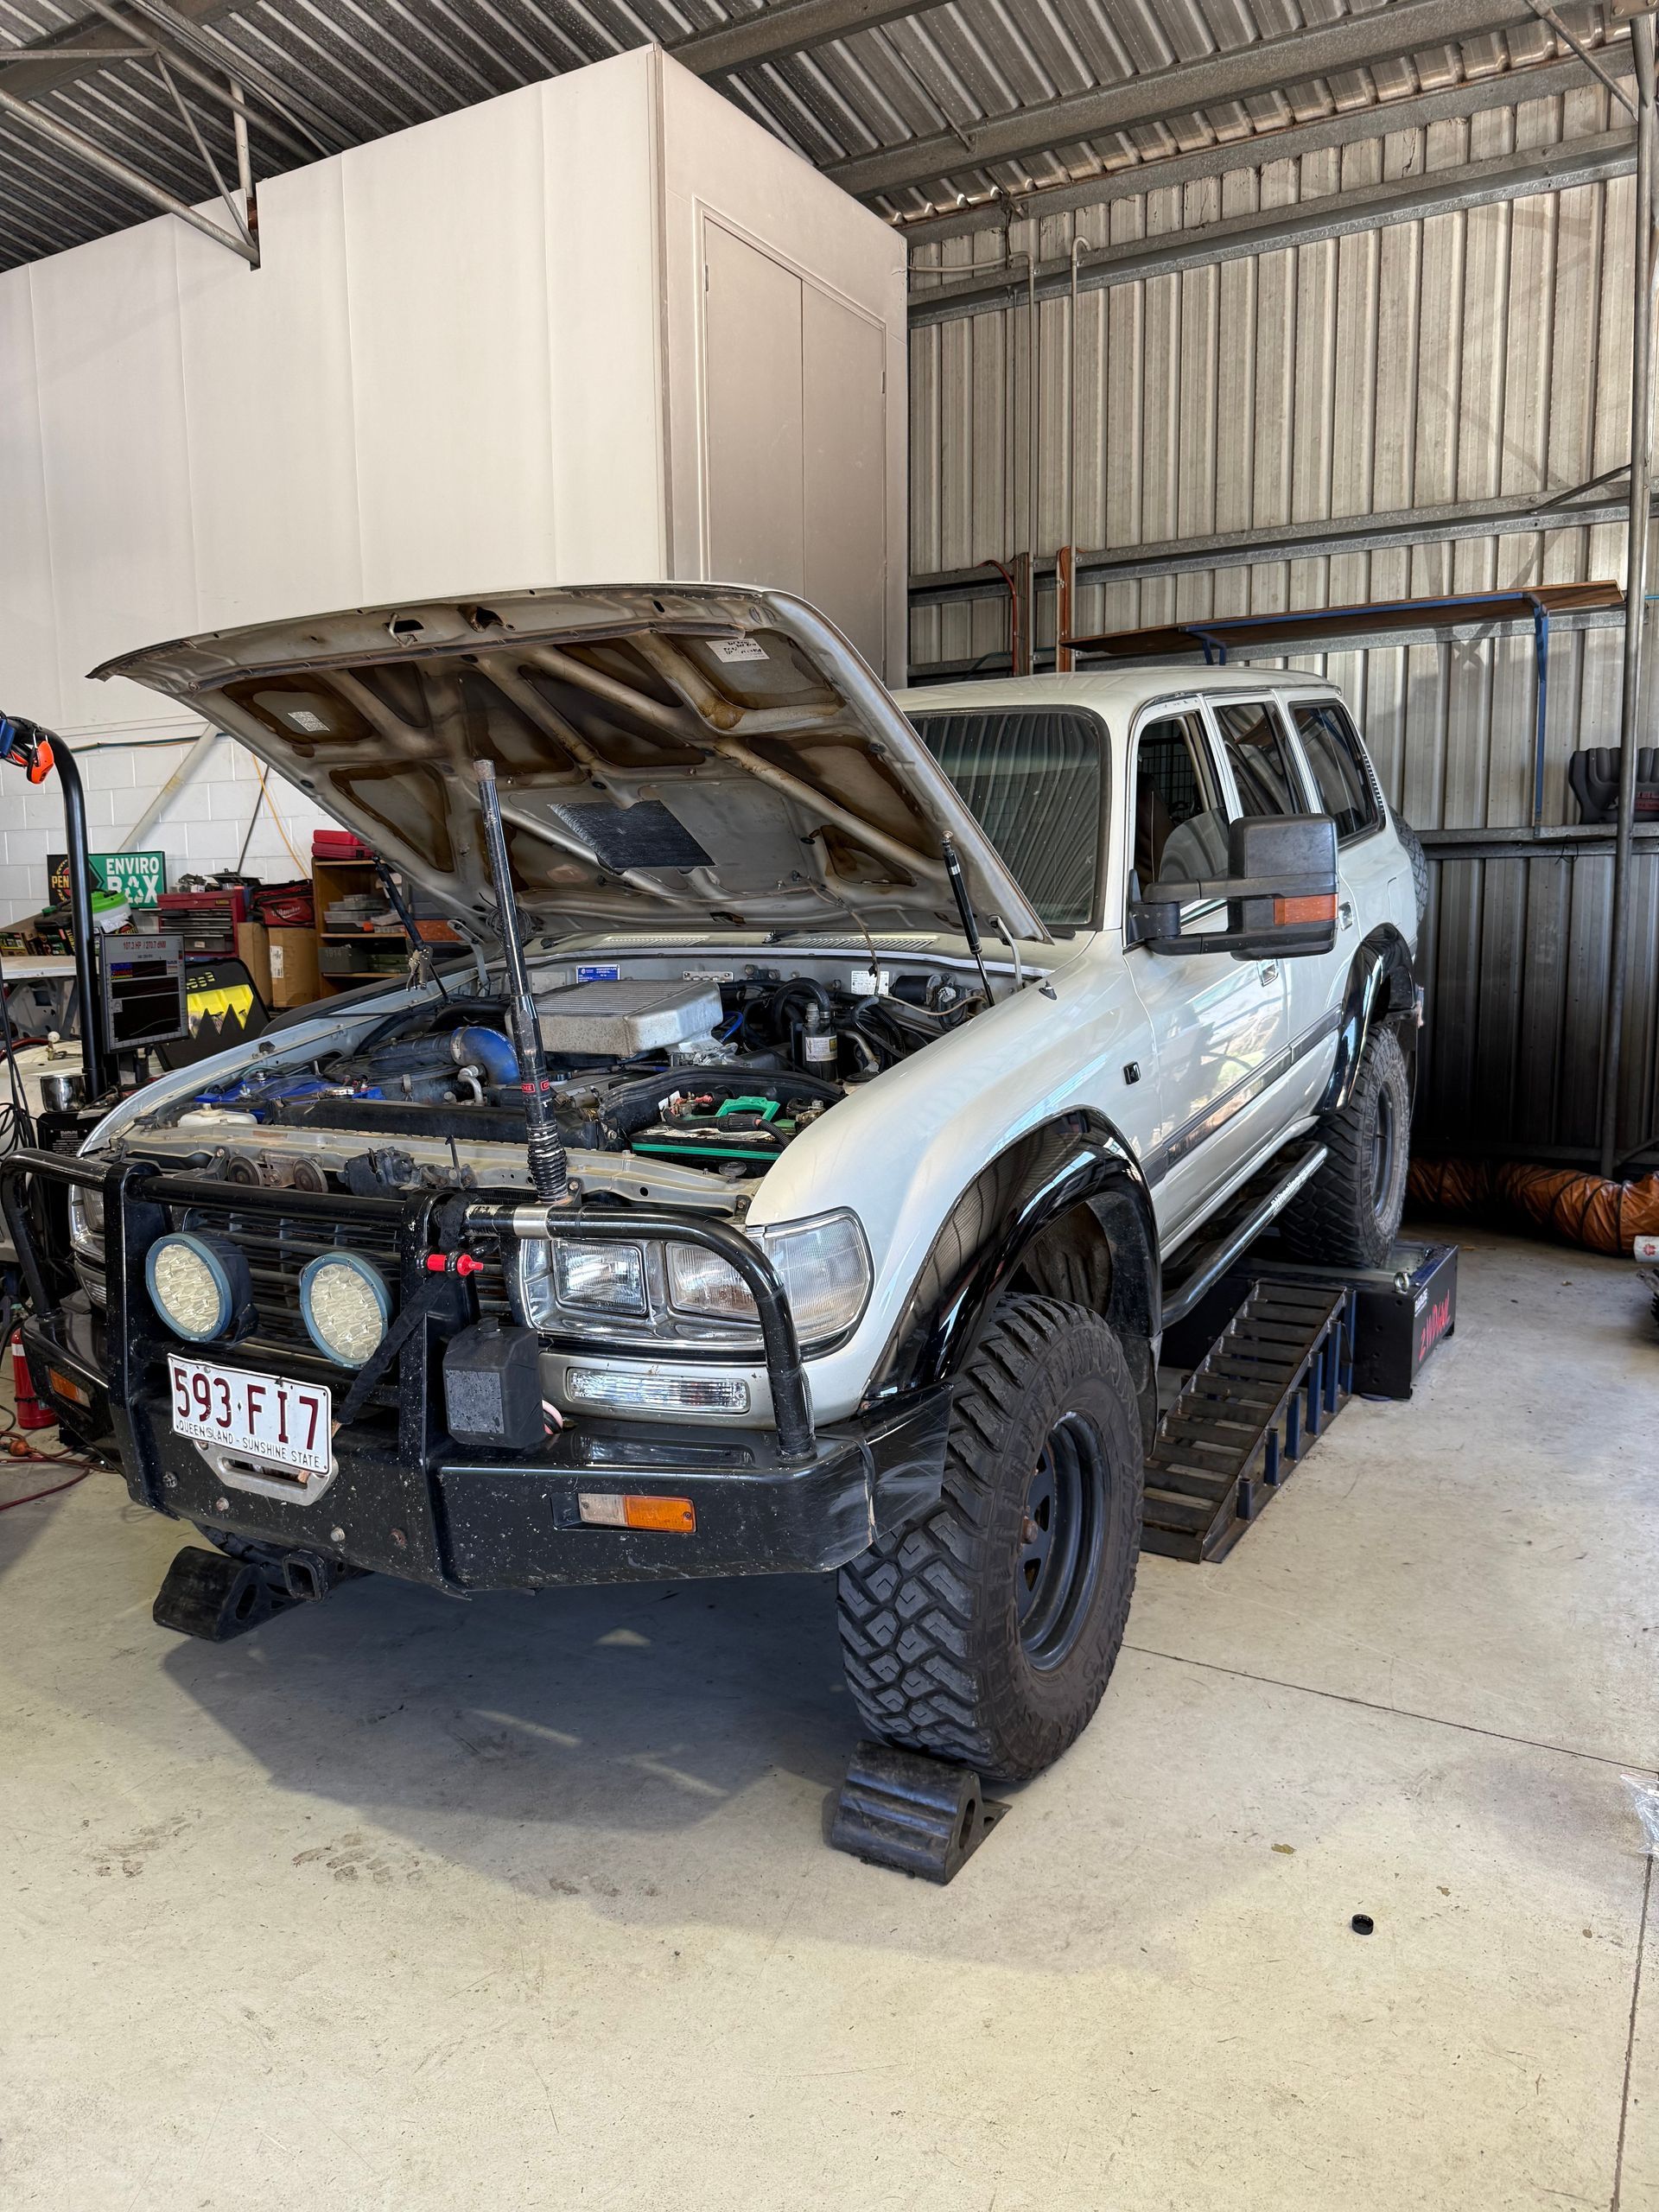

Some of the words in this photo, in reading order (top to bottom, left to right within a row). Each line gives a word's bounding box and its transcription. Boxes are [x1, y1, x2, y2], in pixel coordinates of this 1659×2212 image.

[105, 856, 160, 874] ENVIRO
[179, 1420, 234, 1444] QUEENSLAND
[243, 1438, 287, 1459] SUNSHINE
[291, 1450, 320, 1468] STATE
